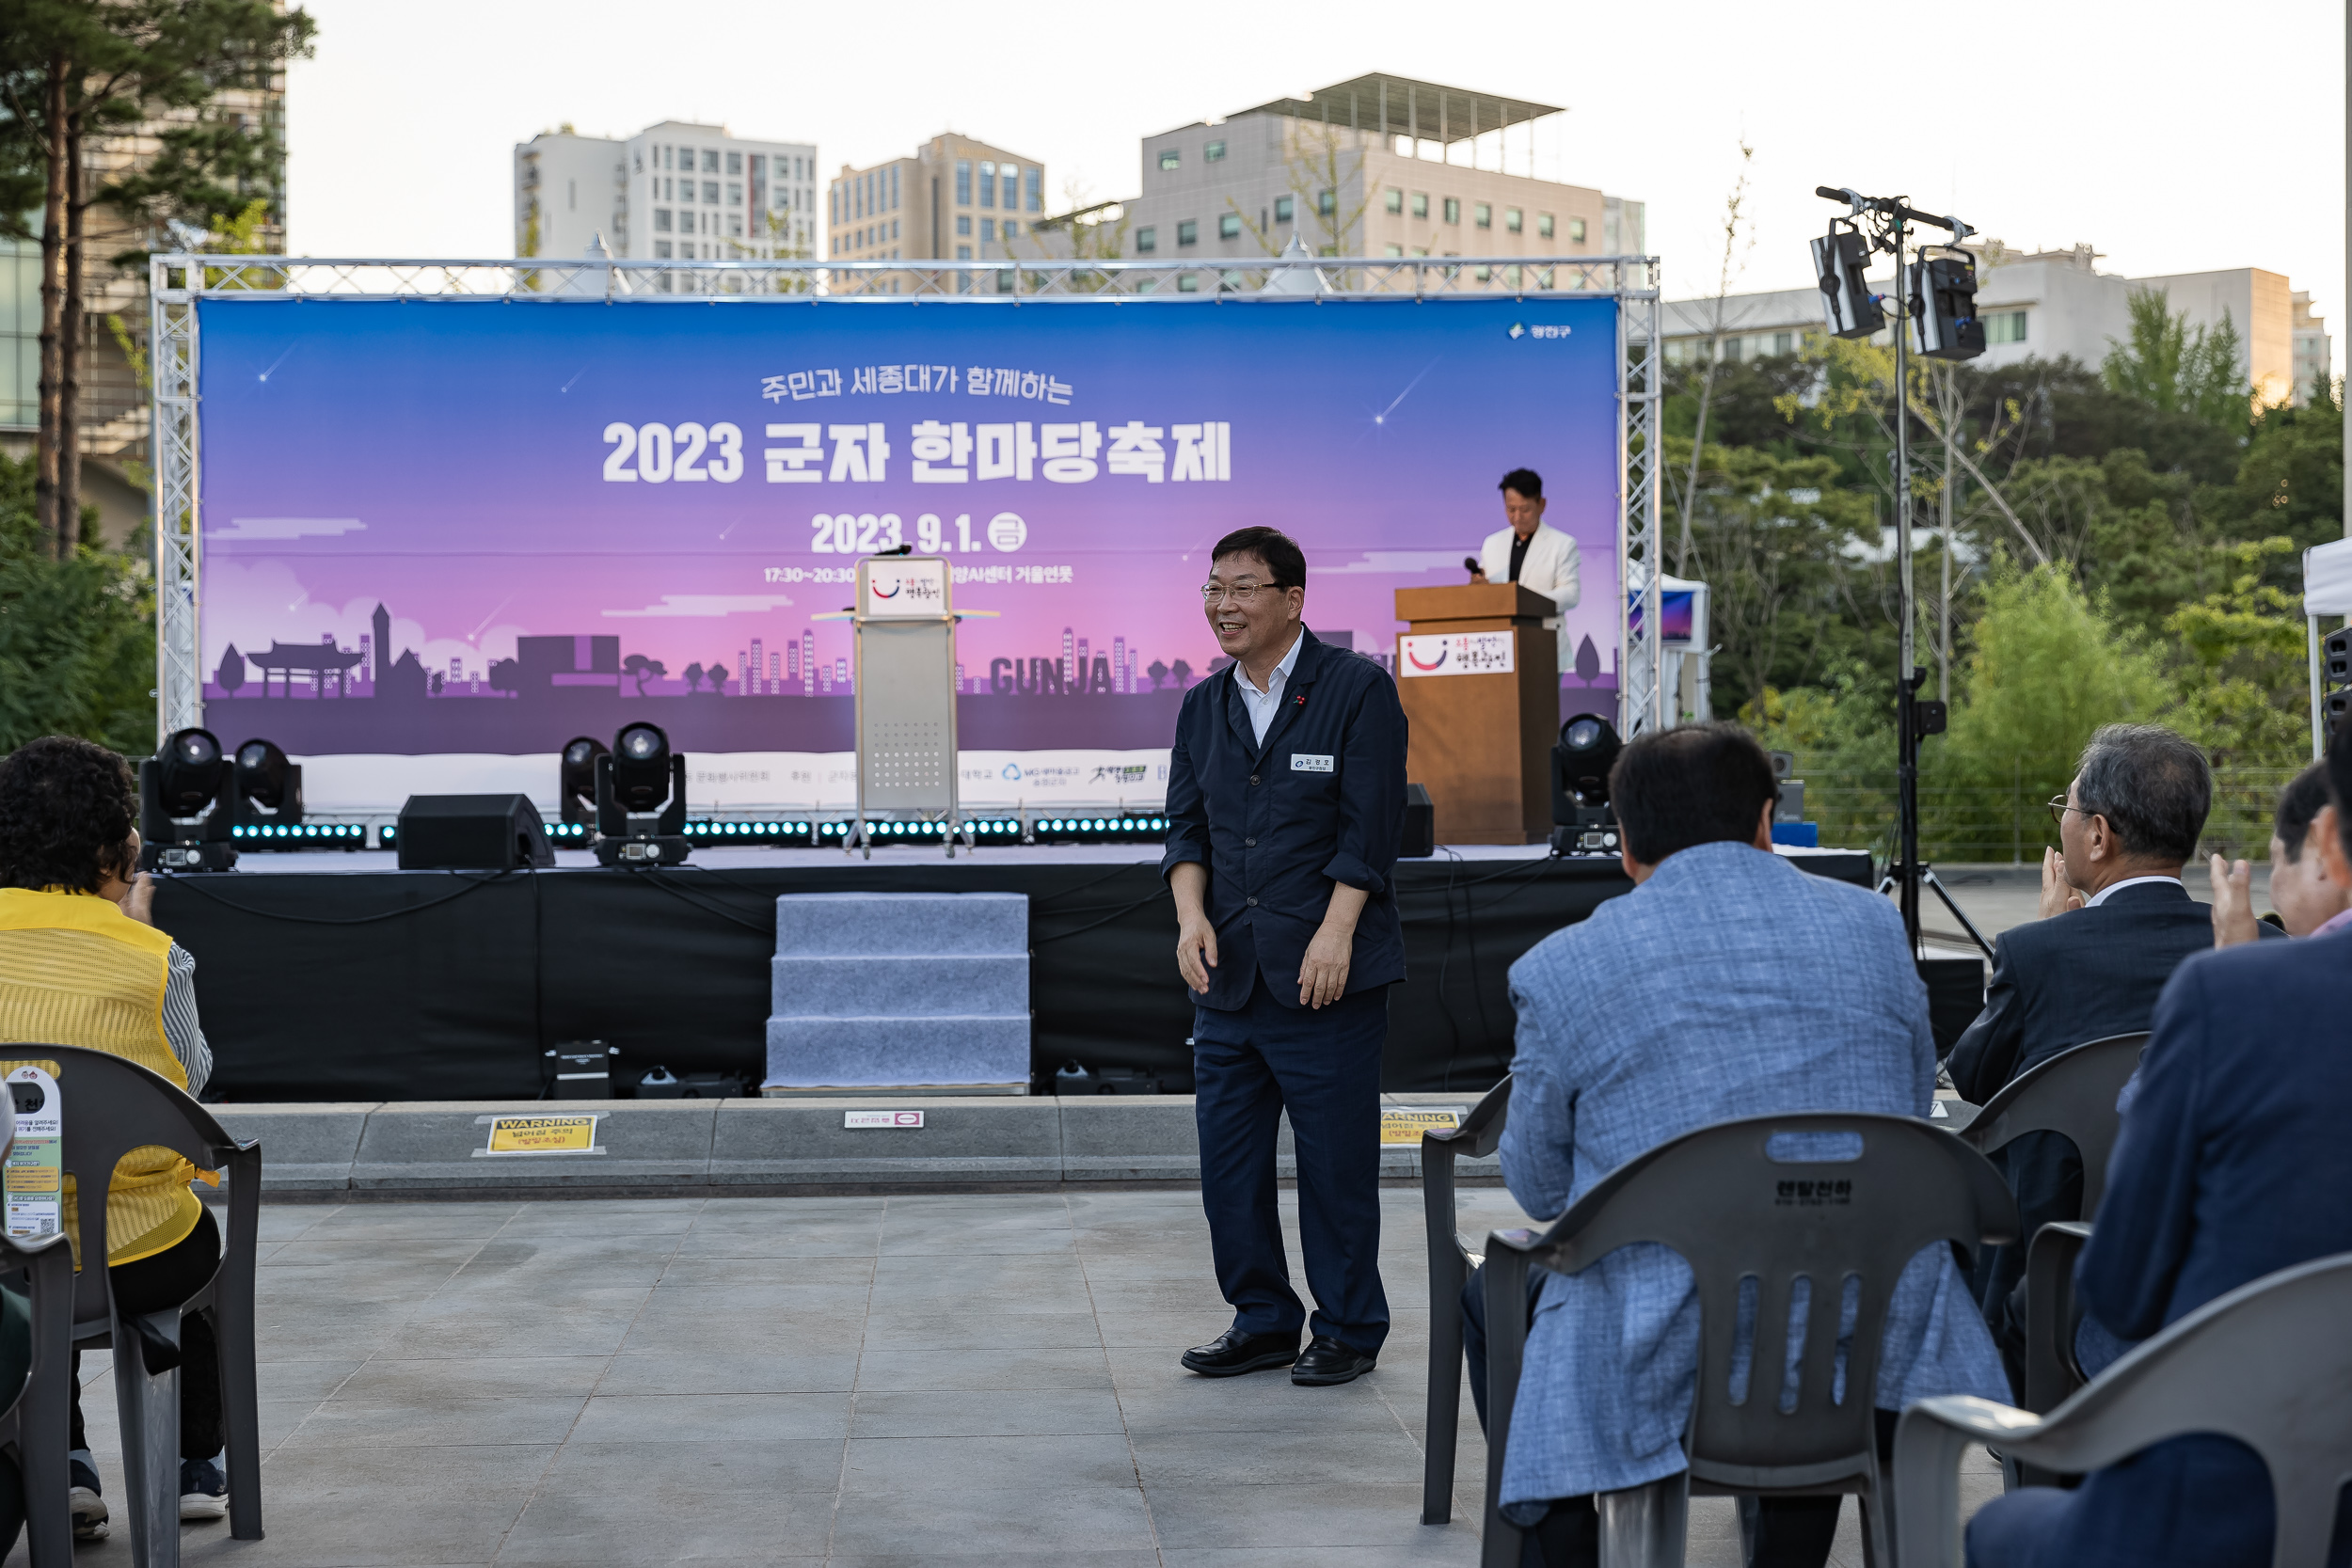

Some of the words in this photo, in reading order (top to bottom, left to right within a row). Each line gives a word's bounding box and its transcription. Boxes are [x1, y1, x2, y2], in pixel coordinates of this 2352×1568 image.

[760, 367, 843, 404] 주민과
[850, 364, 960, 395] 세종대가
[967, 365, 1073, 405] 함께하는
[602, 421, 744, 483] 2023
[764, 422, 890, 483] 군자
[912, 420, 1232, 483] 한마당축제
[764, 567, 855, 583] 17:30~20:30
[950, 566, 1012, 583] 양AI센터
[1015, 566, 1073, 582] 거울연못
[990, 657, 1113, 695] GUNJA
[500, 1117, 590, 1129] WARNING
[1381, 1112, 1450, 1122] ARNING
